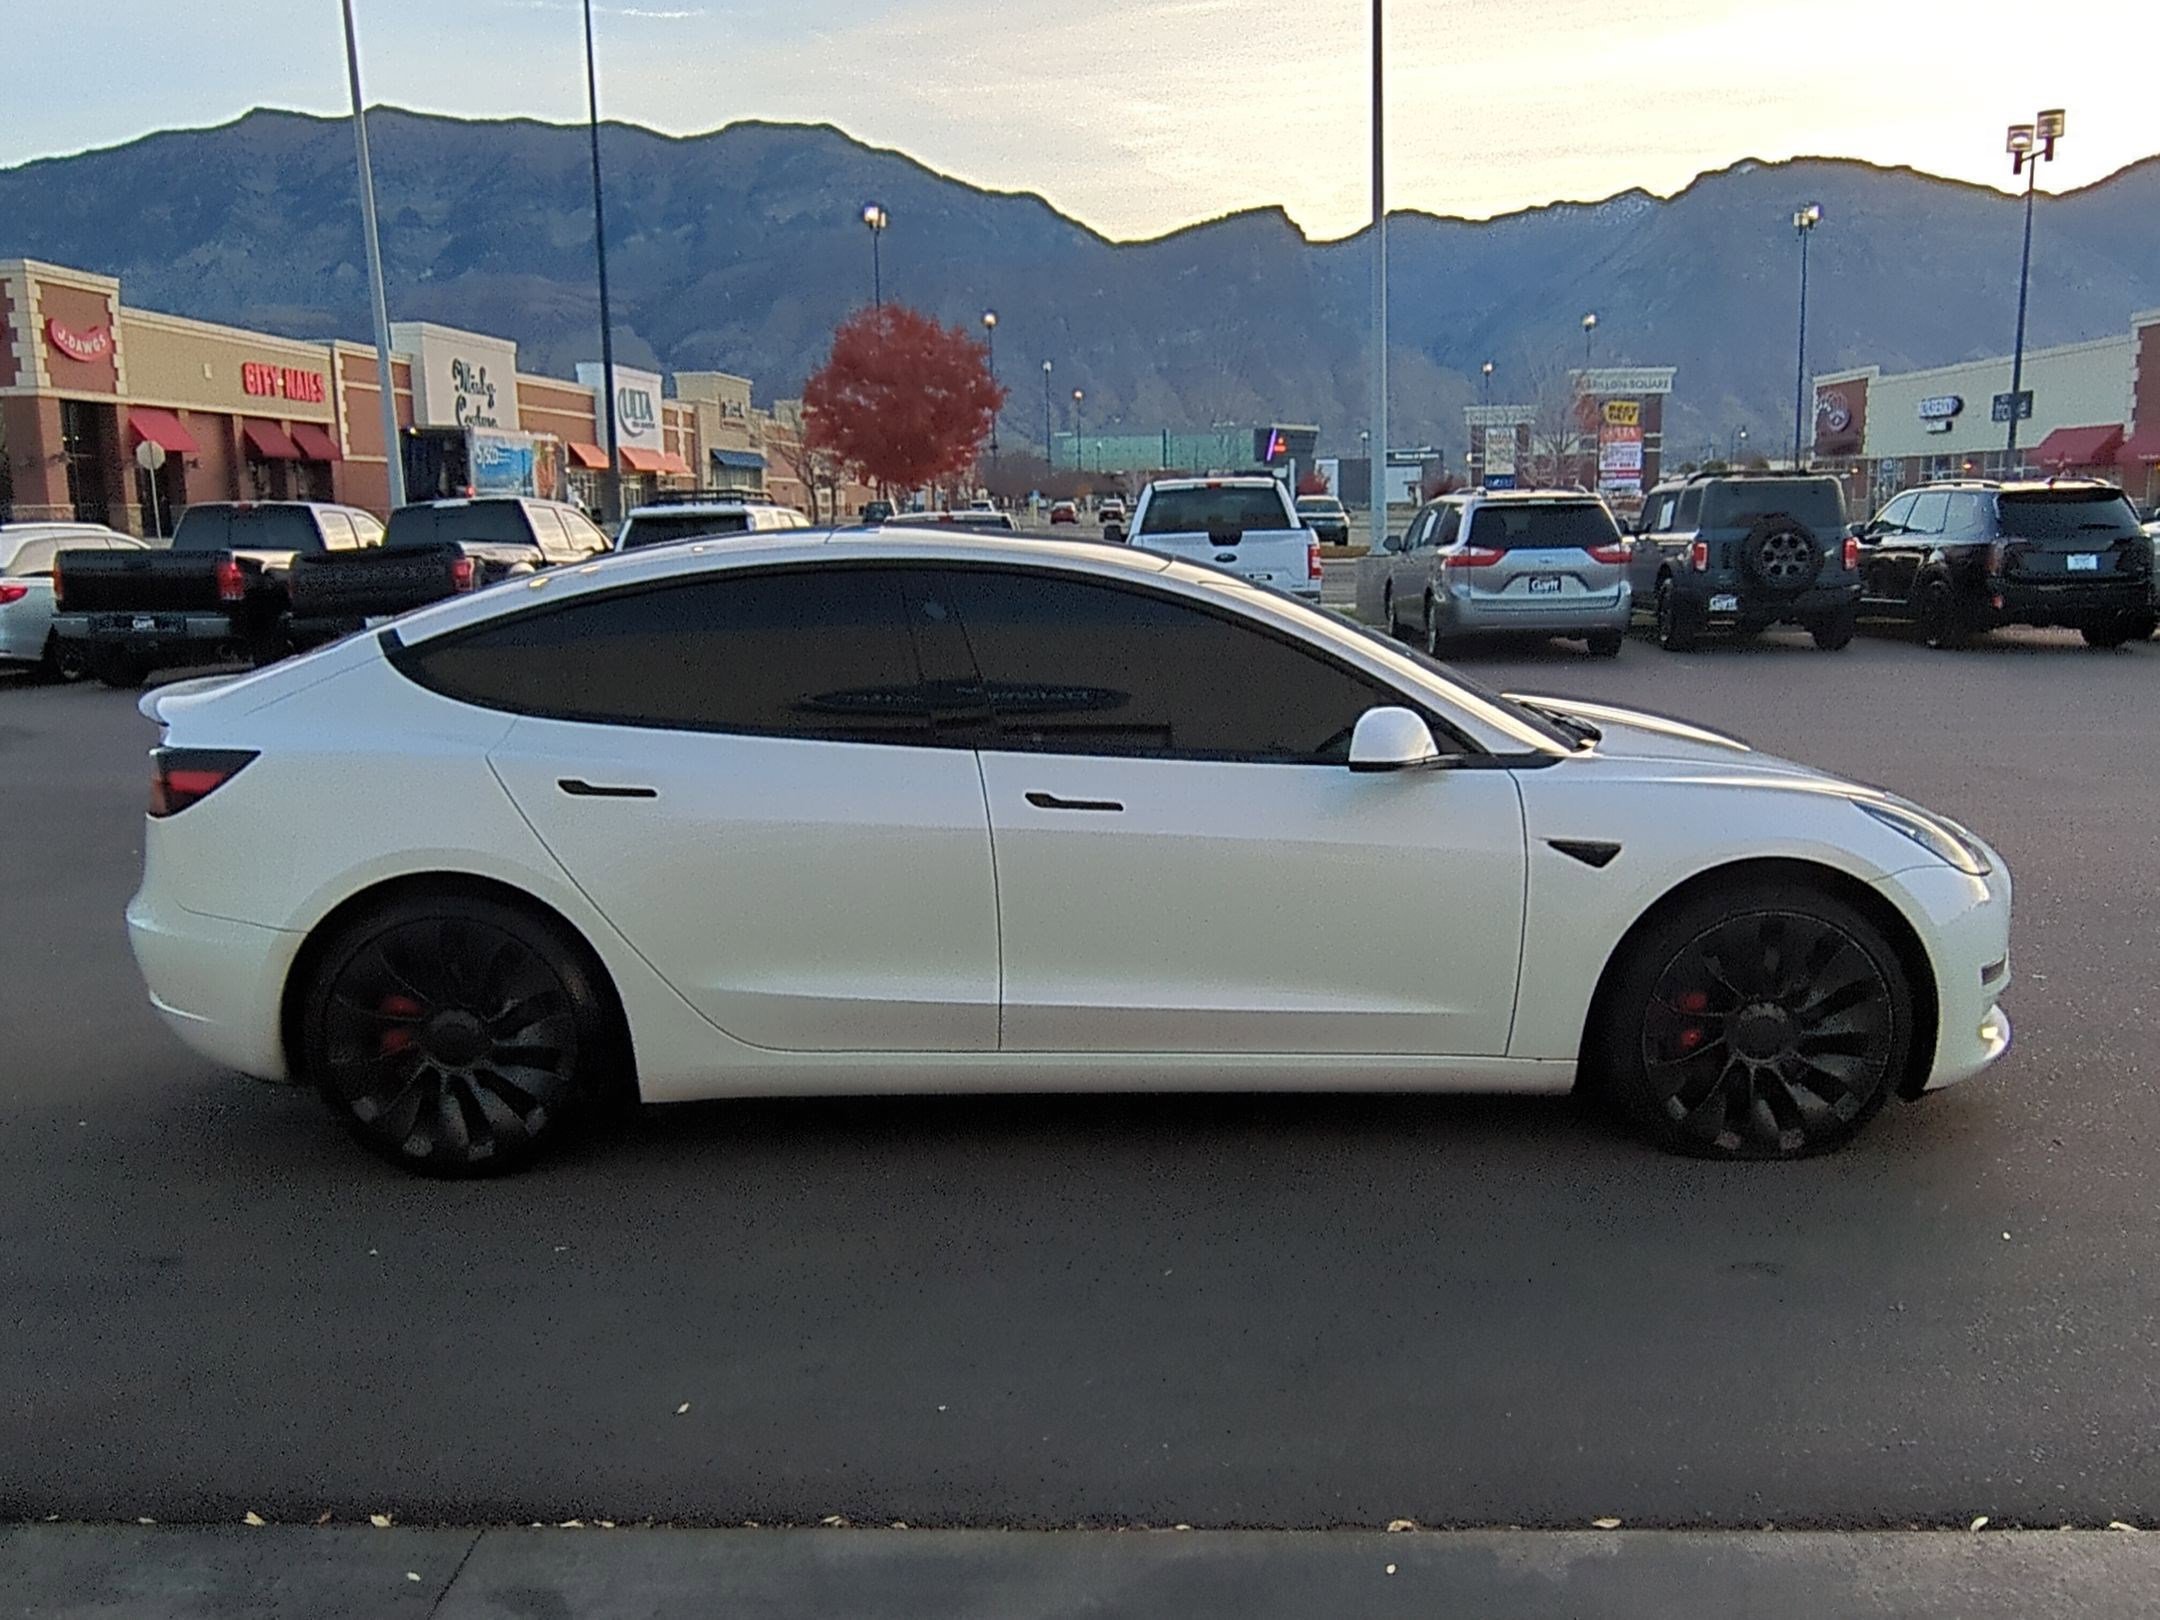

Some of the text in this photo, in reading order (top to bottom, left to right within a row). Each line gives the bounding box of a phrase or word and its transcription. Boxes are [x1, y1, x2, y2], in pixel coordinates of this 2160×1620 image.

[242, 362, 325, 403] CITY NAILS
[620, 388, 654, 421] ULTA
